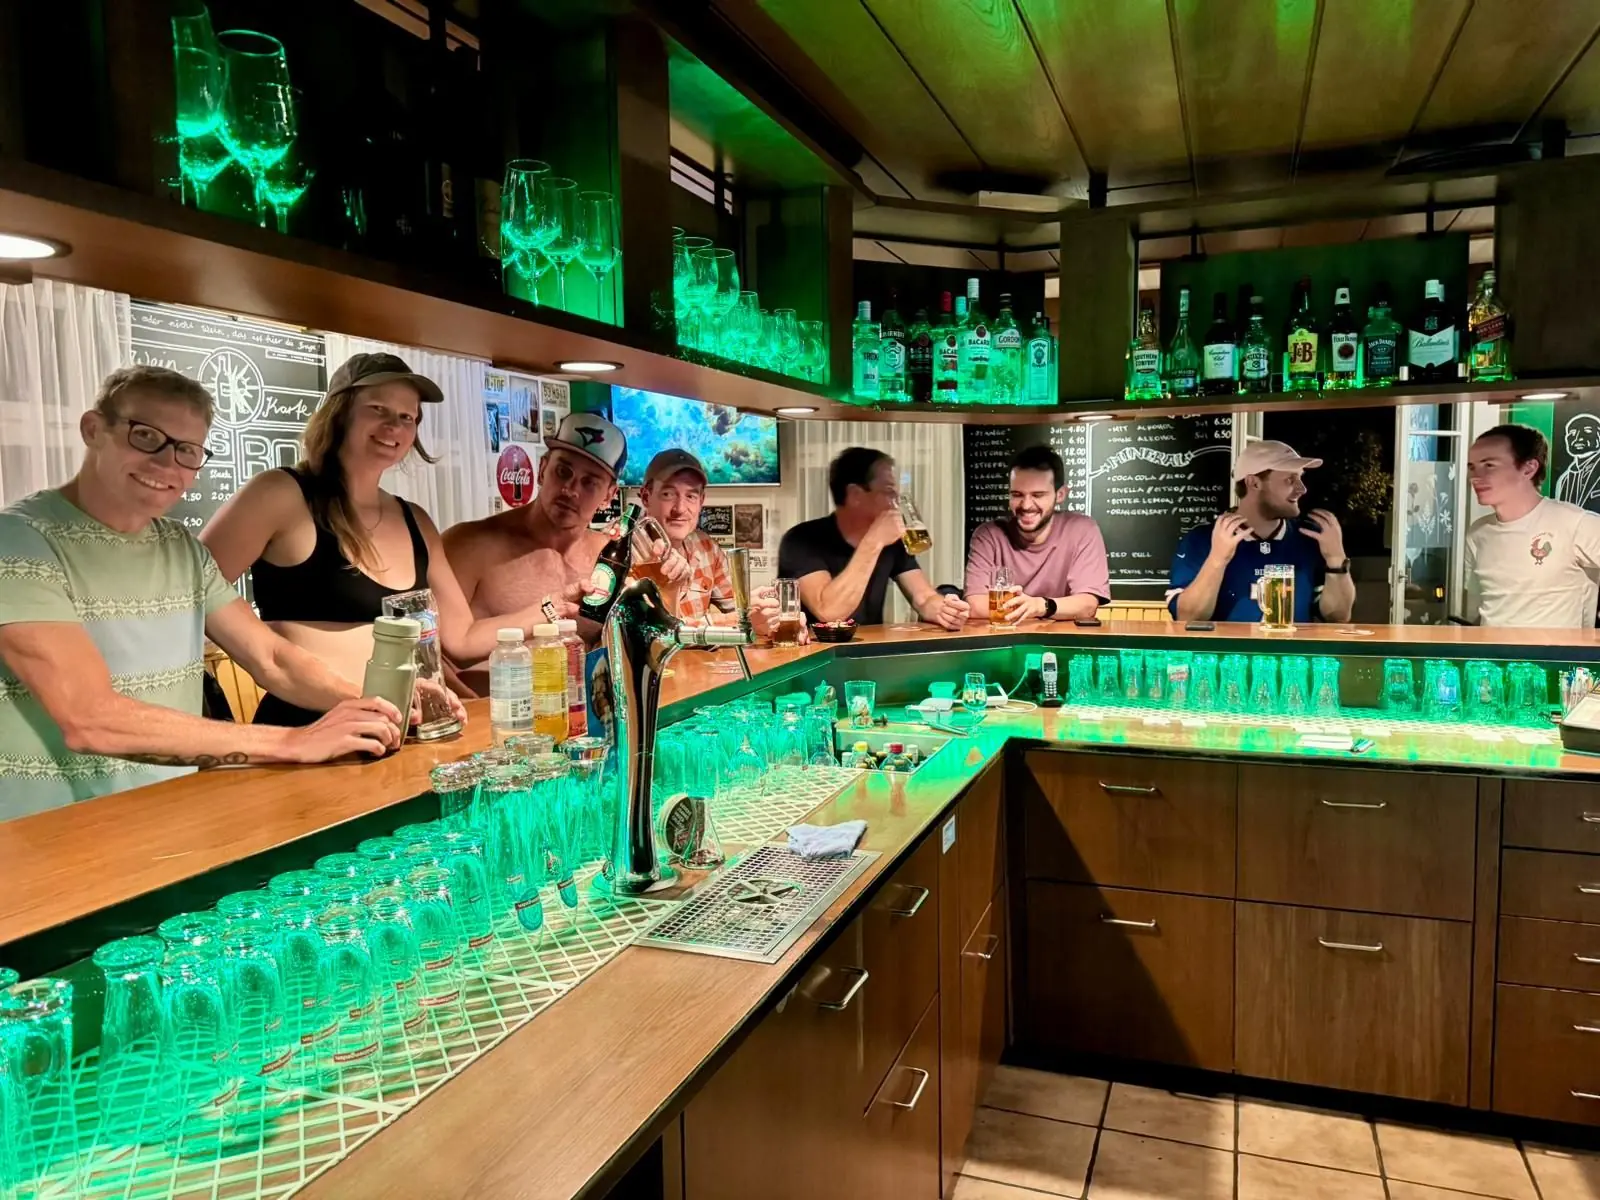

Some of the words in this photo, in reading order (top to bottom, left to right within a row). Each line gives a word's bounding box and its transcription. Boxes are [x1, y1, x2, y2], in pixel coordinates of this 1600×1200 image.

[262, 396, 312, 421] Karte
[1213, 417, 1232, 426] 6.50
[1213, 430, 1232, 439] 6.50
[1107, 446, 1190, 470] MINERAL
